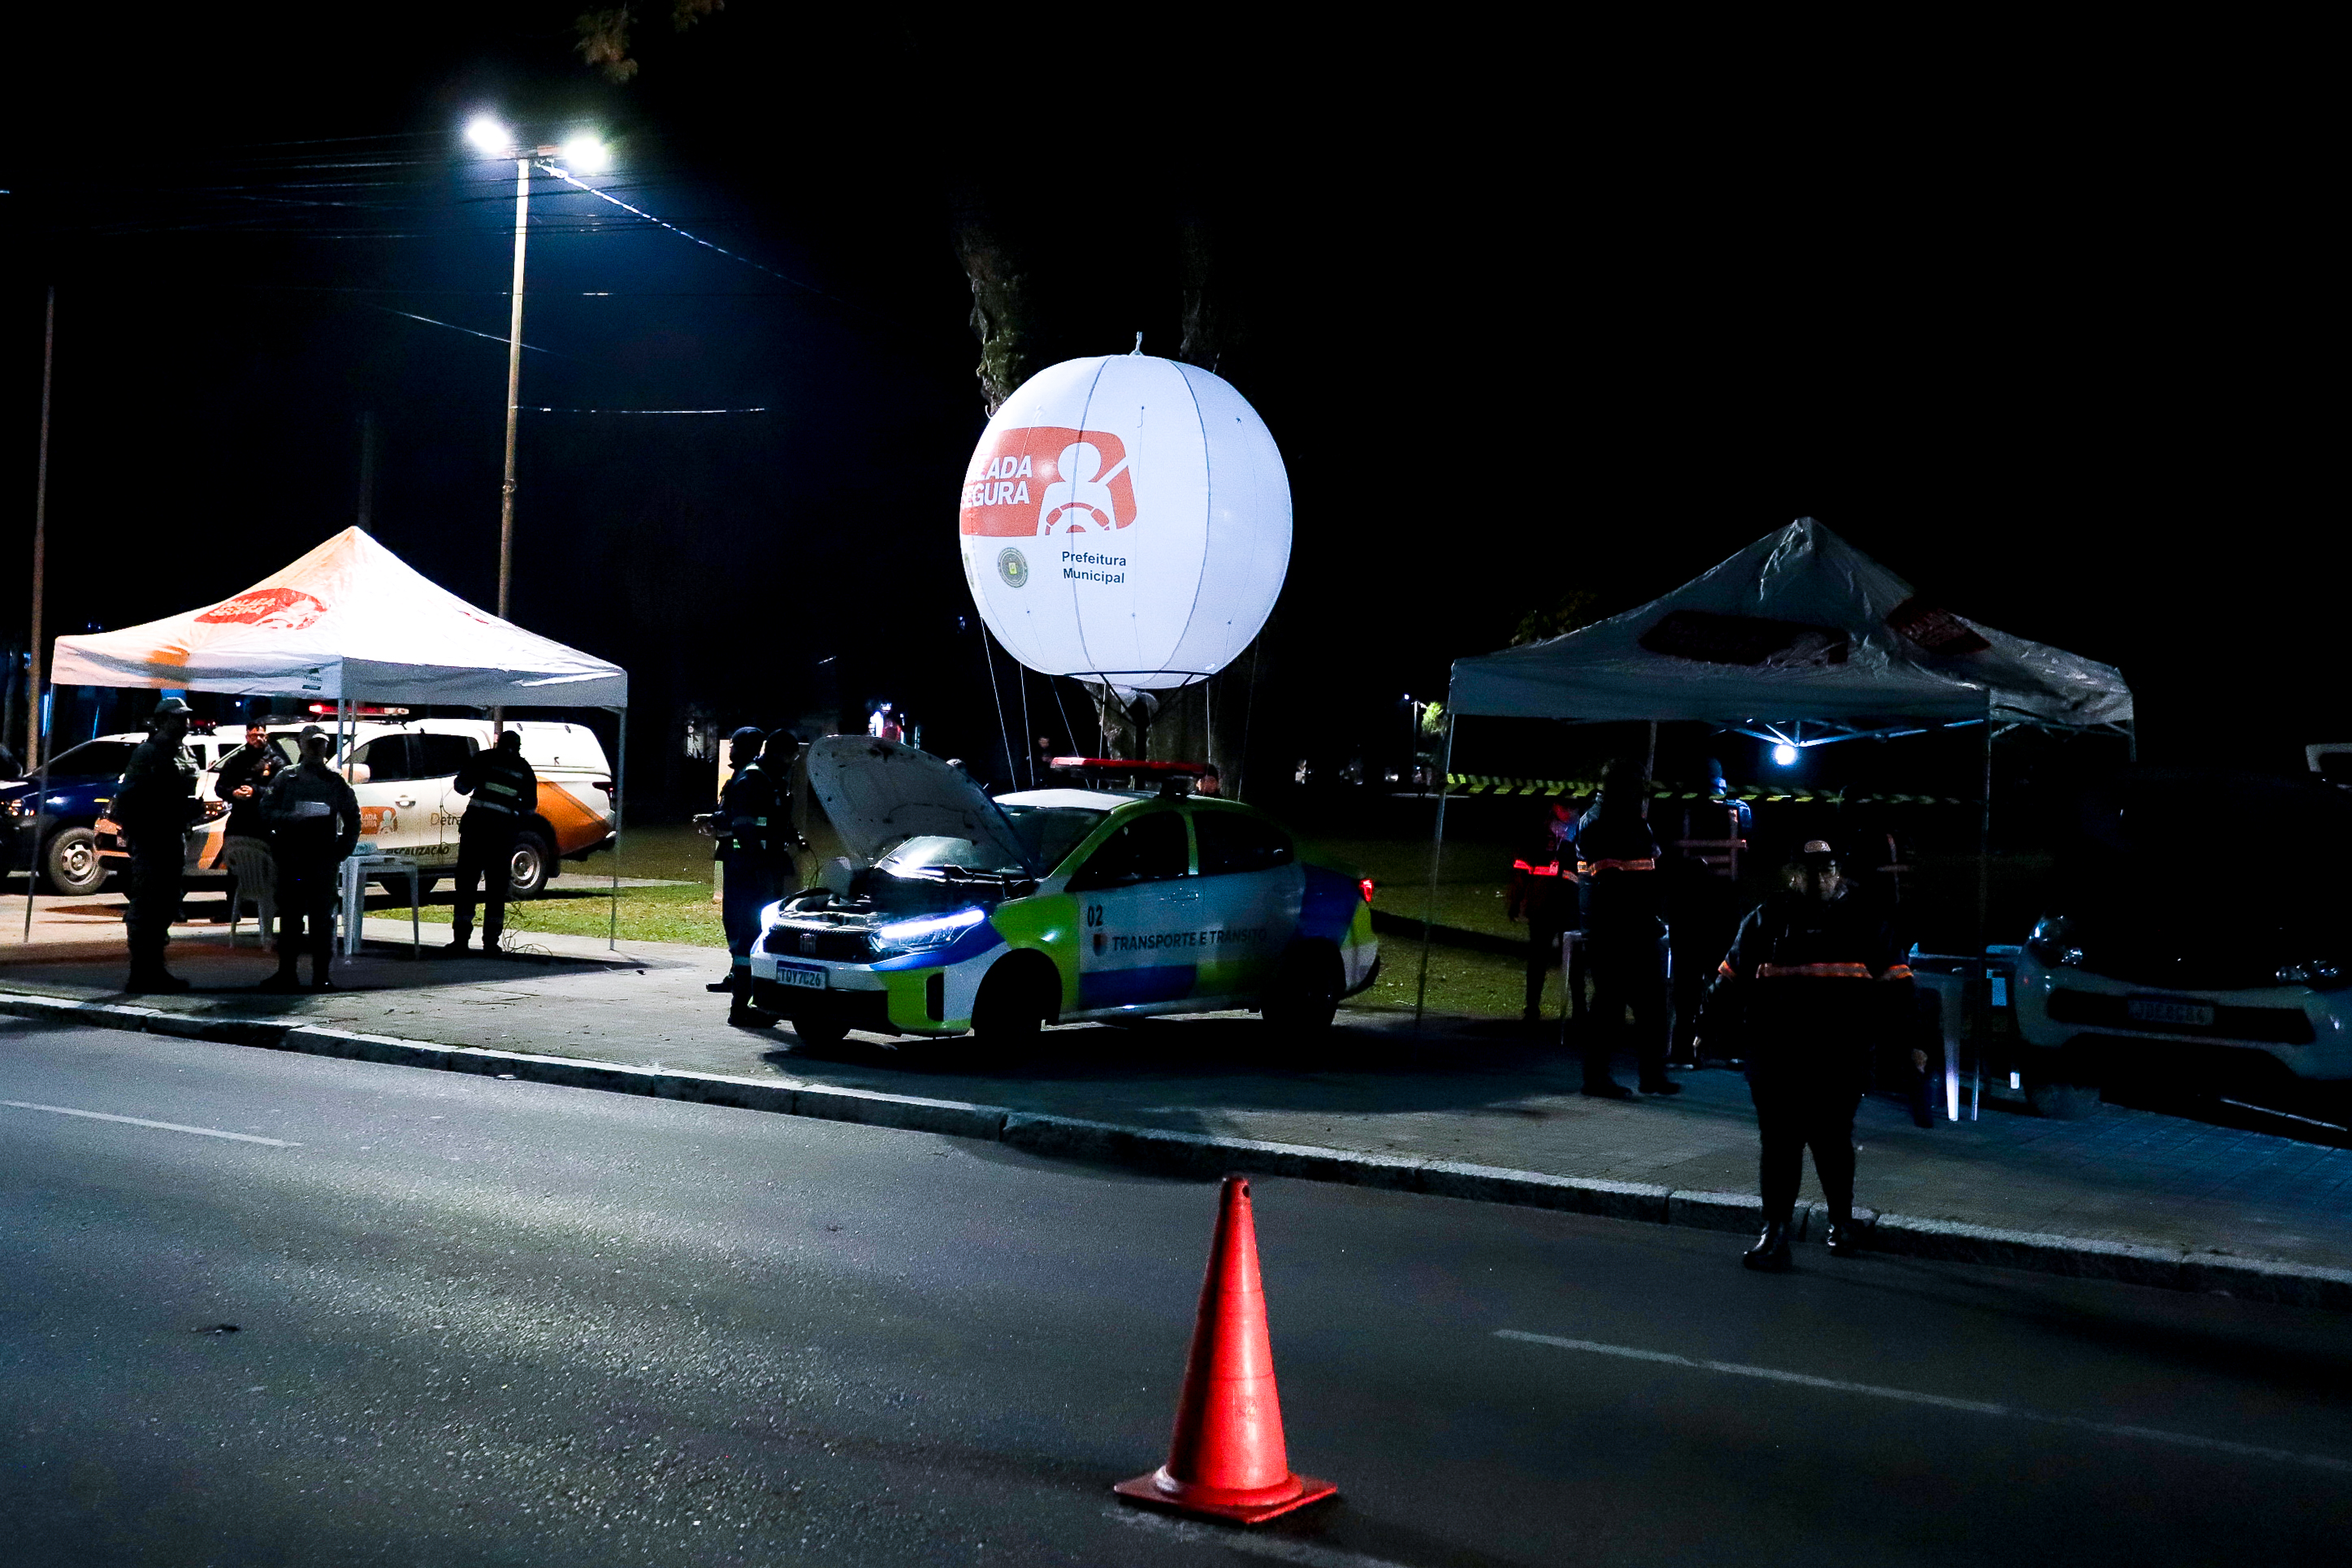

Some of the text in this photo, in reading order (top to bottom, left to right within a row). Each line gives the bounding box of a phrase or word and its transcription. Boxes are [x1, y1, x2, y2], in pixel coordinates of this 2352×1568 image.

[1062, 551, 1126, 566] Prefeitura
[1063, 567, 1124, 585] Municipal
[1087, 904, 1103, 927] 02
[1112, 932, 1196, 951] TRANSPORTE
[1200, 931, 1206, 946] E
